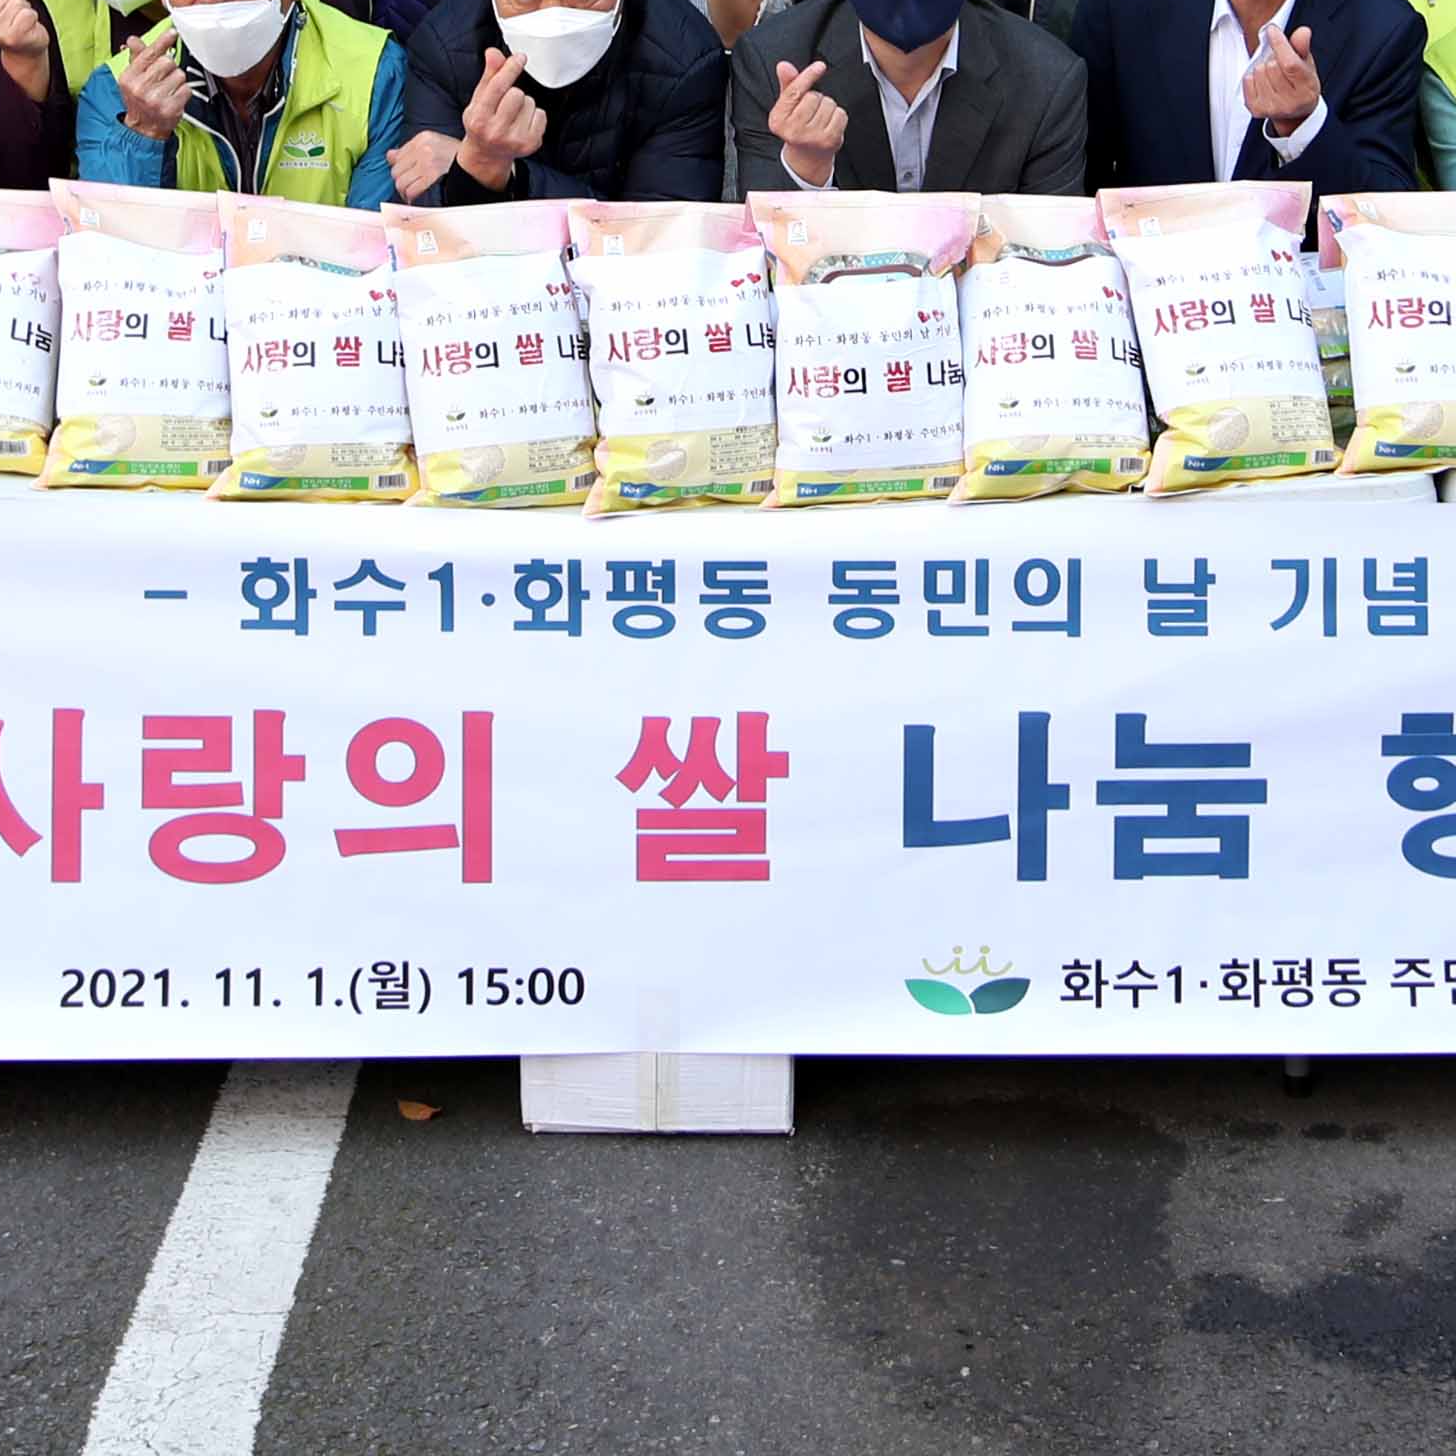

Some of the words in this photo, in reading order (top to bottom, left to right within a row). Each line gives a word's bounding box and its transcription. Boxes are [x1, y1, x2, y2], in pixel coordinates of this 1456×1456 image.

[71, 308, 148, 342] 사랑의
[168, 311, 196, 341] 쌀
[1153, 299, 1236, 336] 사랑의
[1250, 293, 1276, 324] 쌀
[1285, 297, 1314, 327] 나눔
[1368, 297, 1452, 330] 사랑의
[11, 318, 53, 353] 나눔
[242, 338, 316, 374] 사랑의
[333, 336, 362, 368] 쌀
[377, 340, 405, 368] 나
[421, 341, 499, 377] 사랑의
[515, 333, 544, 365] 쌀
[607, 327, 689, 363] 사랑의
[704, 323, 733, 354] 쌀
[974, 330, 1055, 367] 사랑의
[1071, 329, 1099, 361] 쌀
[1111, 336, 1142, 369] 나눔
[787, 365, 866, 398] 사랑의
[884, 361, 912, 393] 쌀
[927, 360, 964, 386] 나눔
[800, 485, 818, 495] NH
[240, 556, 772, 640] 화수1·화평동
[827, 558, 1082, 640] 동민의
[1143, 557, 1217, 637] 날
[1269, 556, 1429, 638] 기념
[614, 711, 790, 882] 쌀
[902, 711, 1268, 882] 나눔
[59, 967, 190, 1009] 2021.
[215, 967, 282, 1008] 11.
[307, 960, 432, 1015] 1.(월)
[457, 967, 585, 1007] 15:00
[1059, 957, 1367, 1009] 화수1·화평동
